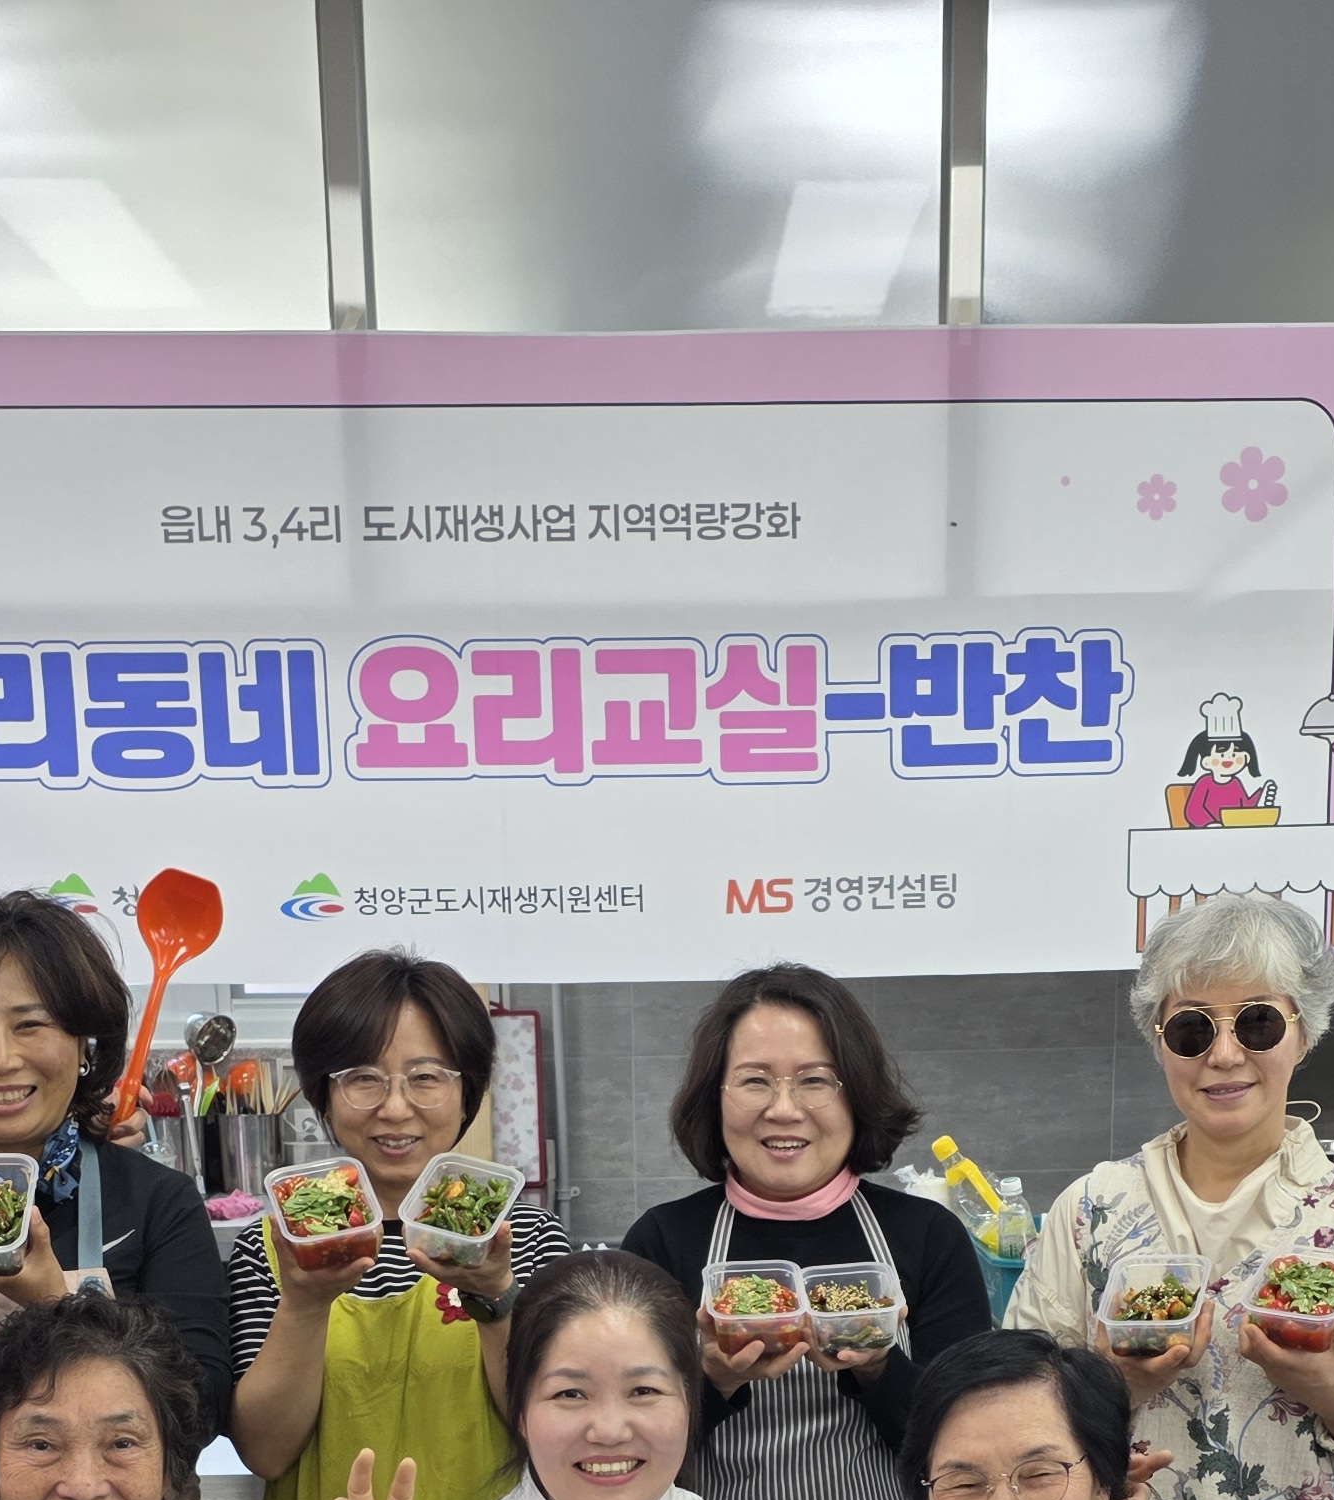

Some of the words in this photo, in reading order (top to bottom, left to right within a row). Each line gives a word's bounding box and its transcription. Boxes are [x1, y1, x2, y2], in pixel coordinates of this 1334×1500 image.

[160, 504, 232, 544] 읍내
[242, 504, 341, 549] 3,4리
[362, 503, 576, 542] 도시재생사업
[587, 501, 802, 542] 지역역량강화
[354, 883, 645, 917] 청양군도시재생지원센터
[725, 878, 794, 915] MS
[803, 872, 958, 913] 경영컨설팅
